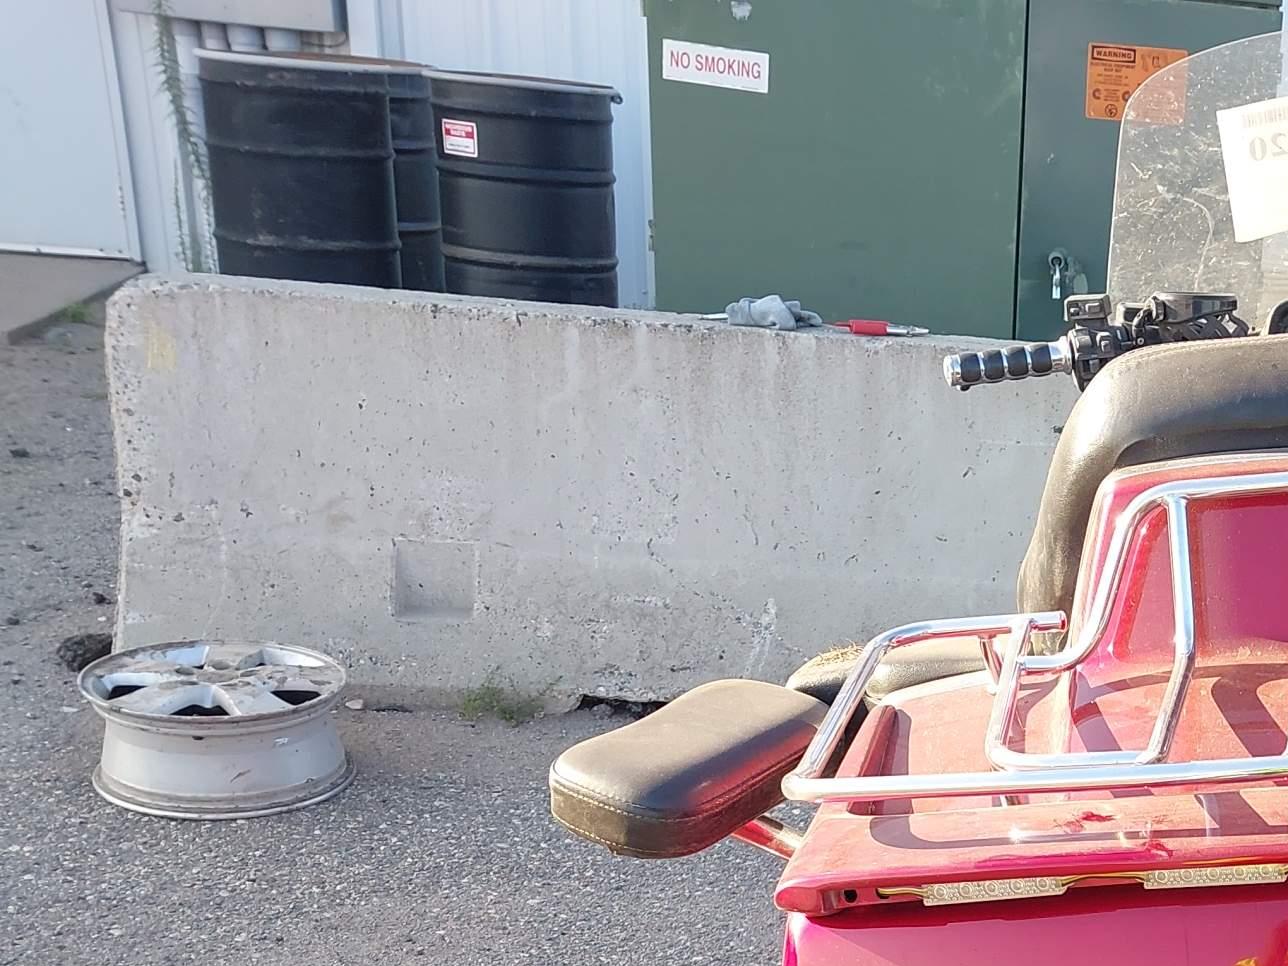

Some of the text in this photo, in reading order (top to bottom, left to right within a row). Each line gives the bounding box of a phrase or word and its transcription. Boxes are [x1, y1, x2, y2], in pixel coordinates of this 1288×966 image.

[1095, 50, 1132, 59] WARNING
[670, 50, 761, 80] NO SMOKING
